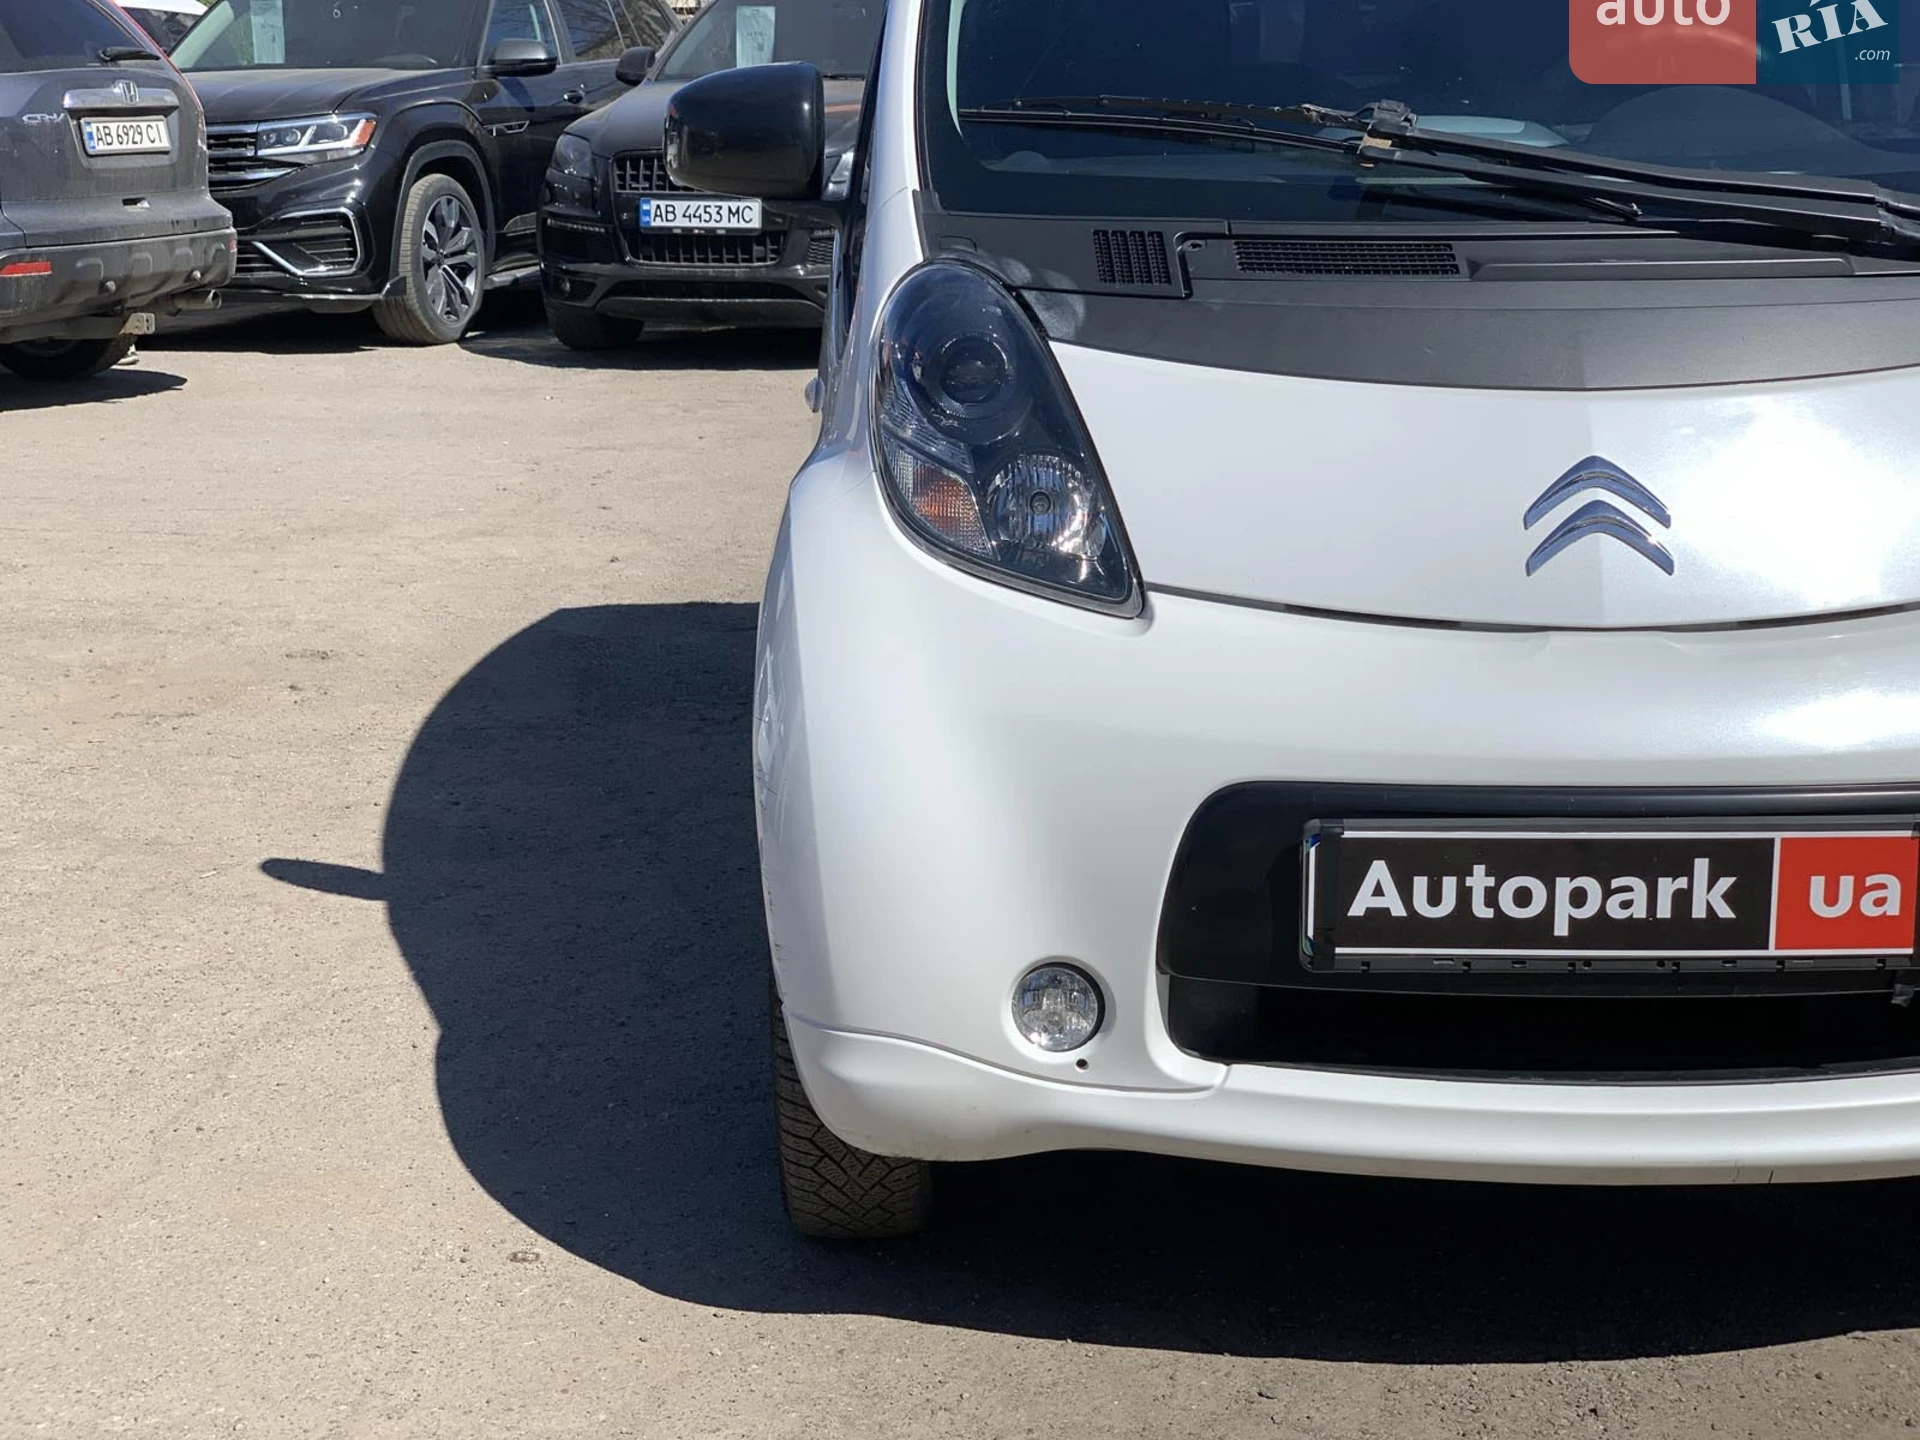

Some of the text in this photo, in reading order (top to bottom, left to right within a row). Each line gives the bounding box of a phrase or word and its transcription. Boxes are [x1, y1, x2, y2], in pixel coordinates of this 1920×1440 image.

[96, 125, 114, 146] AB
[116, 124, 143, 145] 6929
[145, 123, 162, 144] CI
[653, 203, 753, 224] AB 4453 MC
[1347, 857, 1902, 937] Autopark ua
